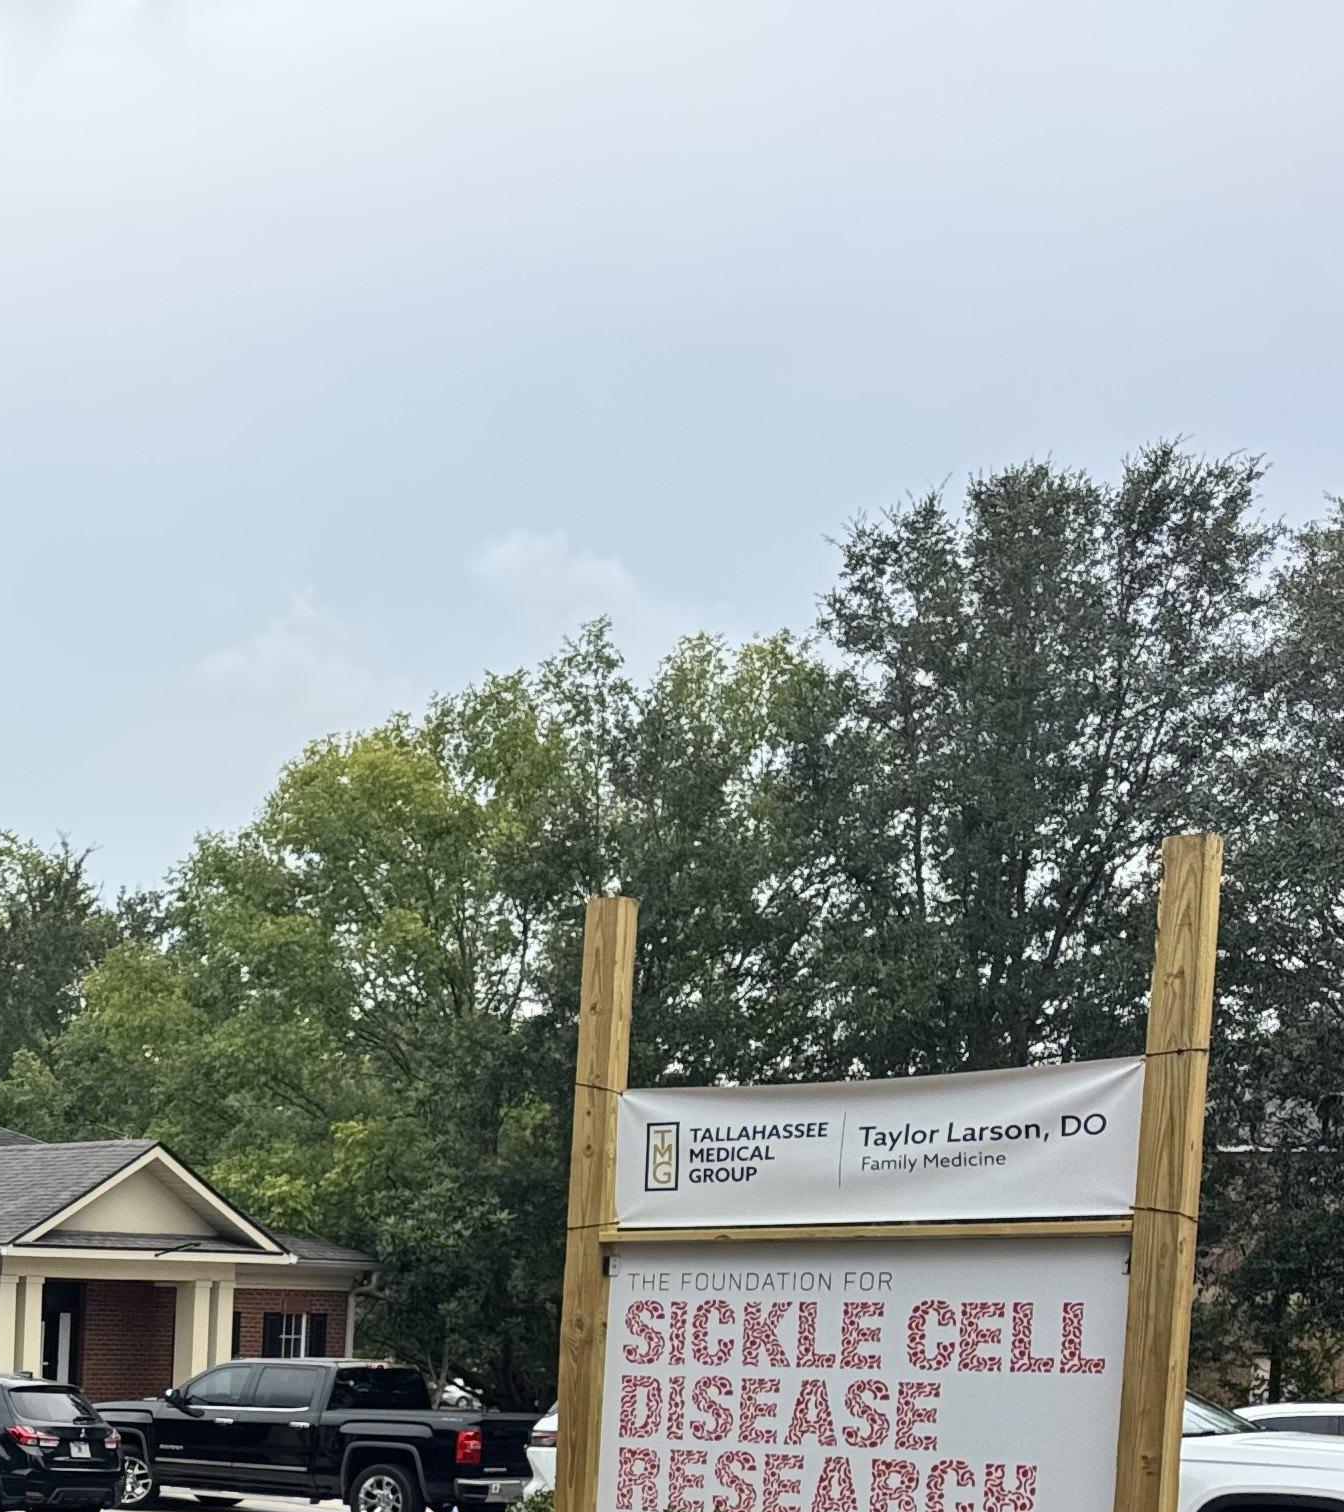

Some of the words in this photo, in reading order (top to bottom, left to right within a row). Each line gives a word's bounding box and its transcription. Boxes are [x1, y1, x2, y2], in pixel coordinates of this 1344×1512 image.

[689, 1122, 830, 1143] TALLAHASSEE
[859, 1122, 940, 1152] Taylor
[947, 1121, 1050, 1143] Larson,
[1061, 1113, 1108, 1138] DO
[689, 1145, 776, 1164] MEDICAL
[861, 1153, 918, 1174] Family
[923, 1151, 1008, 1170] Medicine
[688, 1166, 759, 1184] GROUP
[627, 1272, 671, 1292] THE
[680, 1271, 833, 1292] FOUNDATION
[843, 1271, 894, 1292] FOR
[622, 1299, 885, 1370] SICKLE
[906, 1299, 1106, 1374] CELL
[618, 1374, 942, 1451] DISEASE
